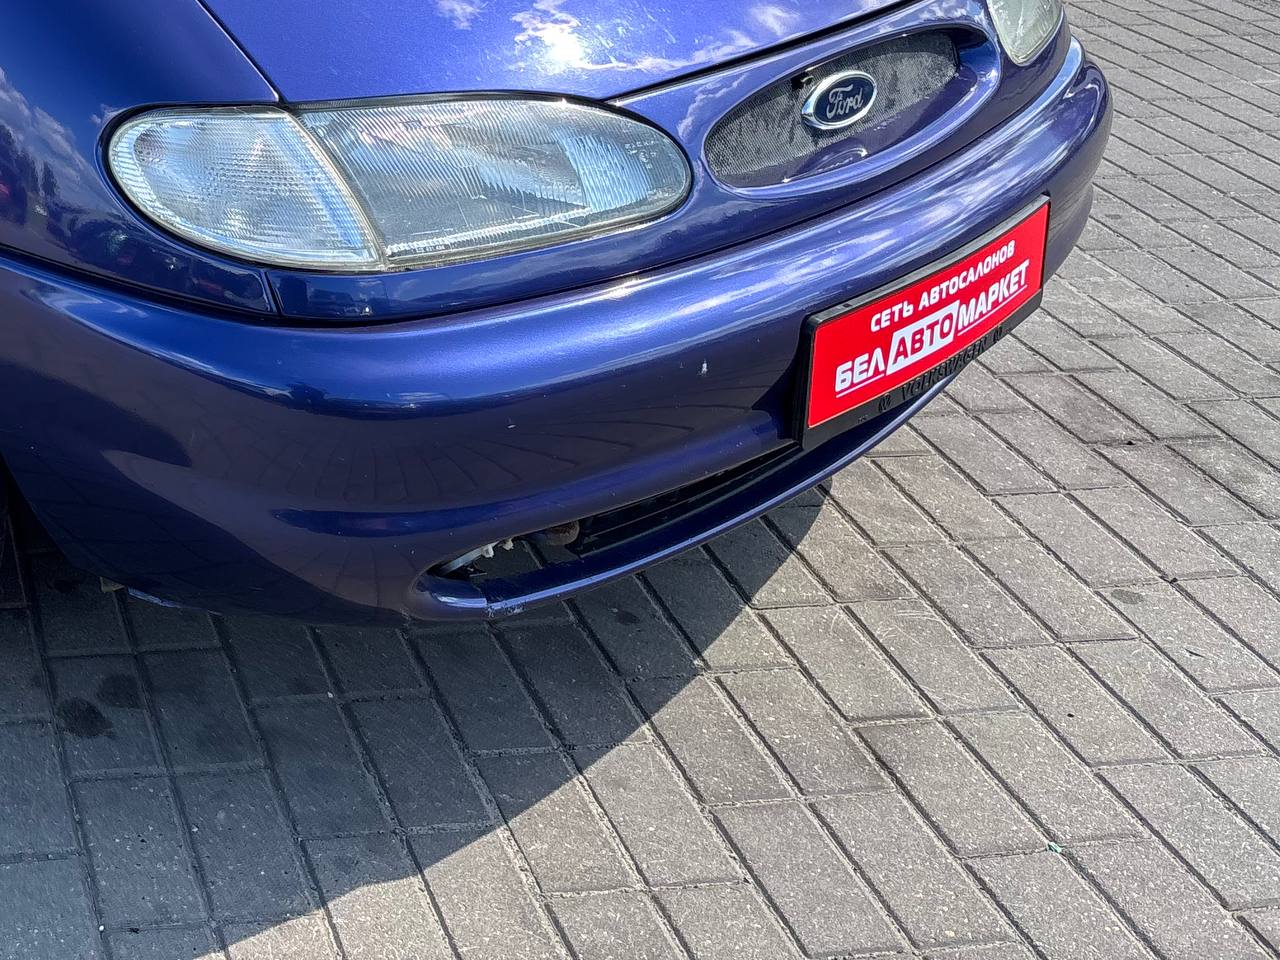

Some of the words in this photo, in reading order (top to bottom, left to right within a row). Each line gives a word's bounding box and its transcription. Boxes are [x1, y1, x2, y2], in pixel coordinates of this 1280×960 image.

[826, 84, 863, 119] Ford
[834, 259, 1030, 392] БЕЛАВТОМАРКЕТ
[870, 302, 914, 333] СЕТЬ
[918, 240, 1016, 311] АВТОСАЛОНОВ
